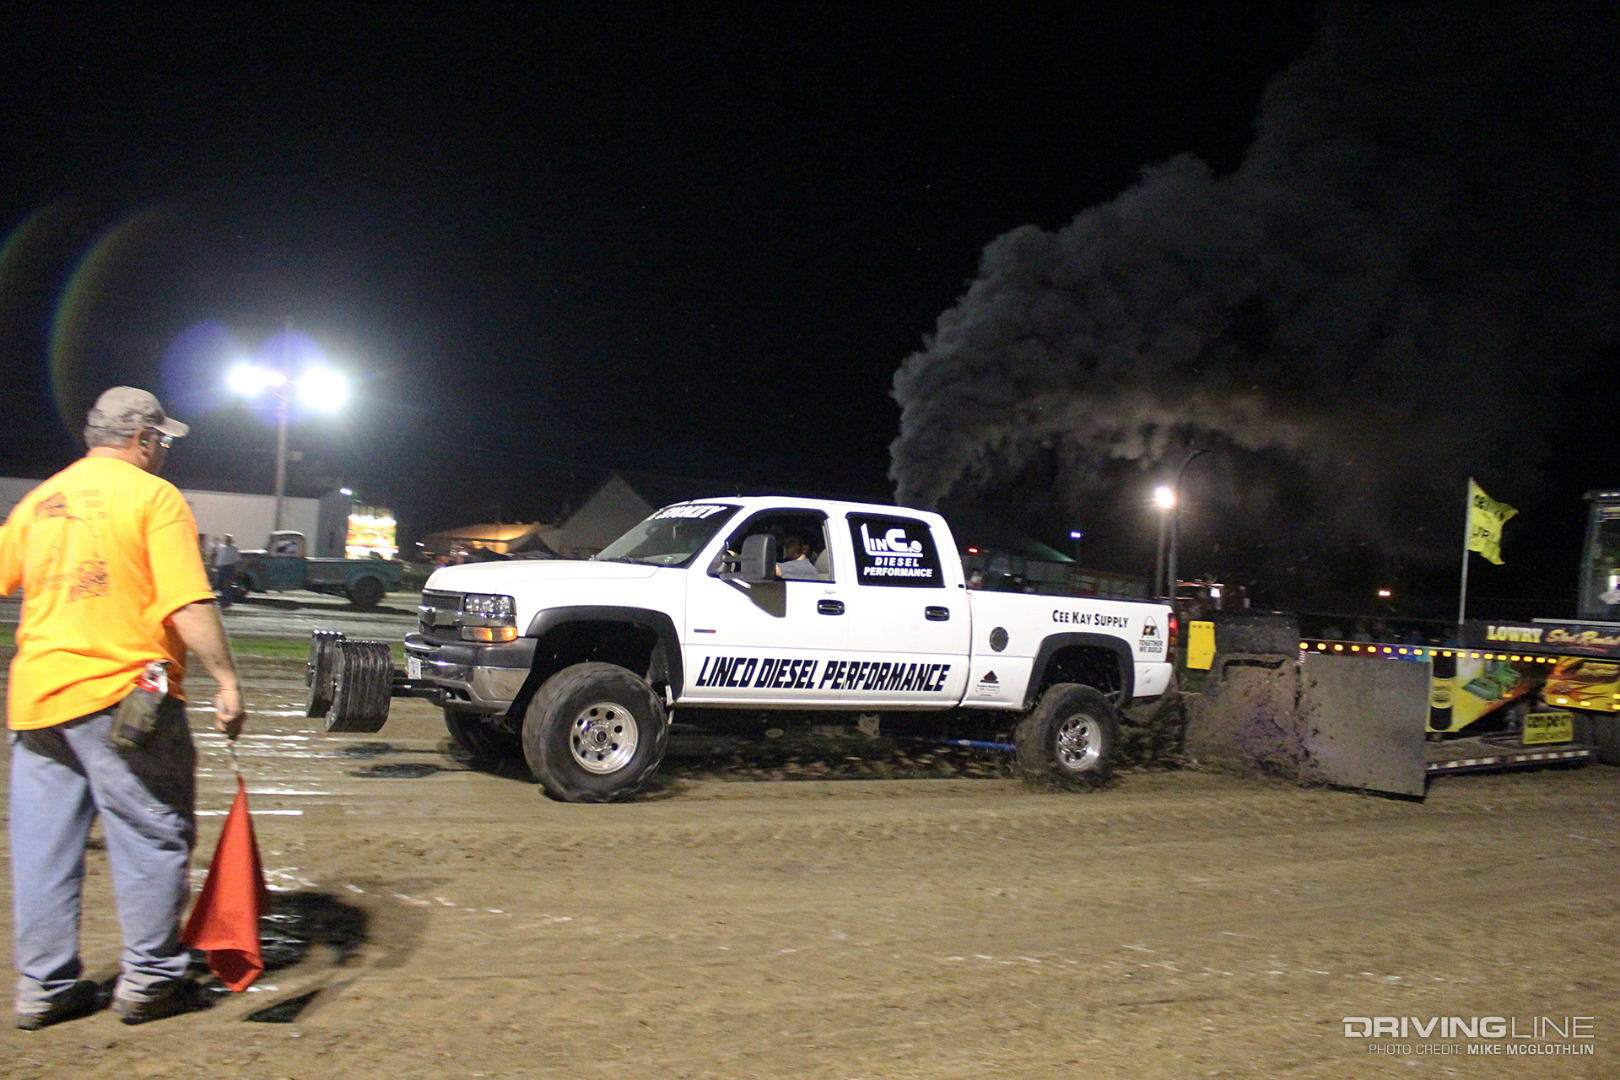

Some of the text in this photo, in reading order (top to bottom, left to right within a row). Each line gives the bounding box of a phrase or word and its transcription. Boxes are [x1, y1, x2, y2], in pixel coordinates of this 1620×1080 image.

[874, 557, 920, 567] DIESEL
[863, 567, 933, 577] PERFORMANCE
[1486, 625, 1543, 643] LOWRY
[695, 656, 951, 691] LINCO DIESEL PERFORMANCE
